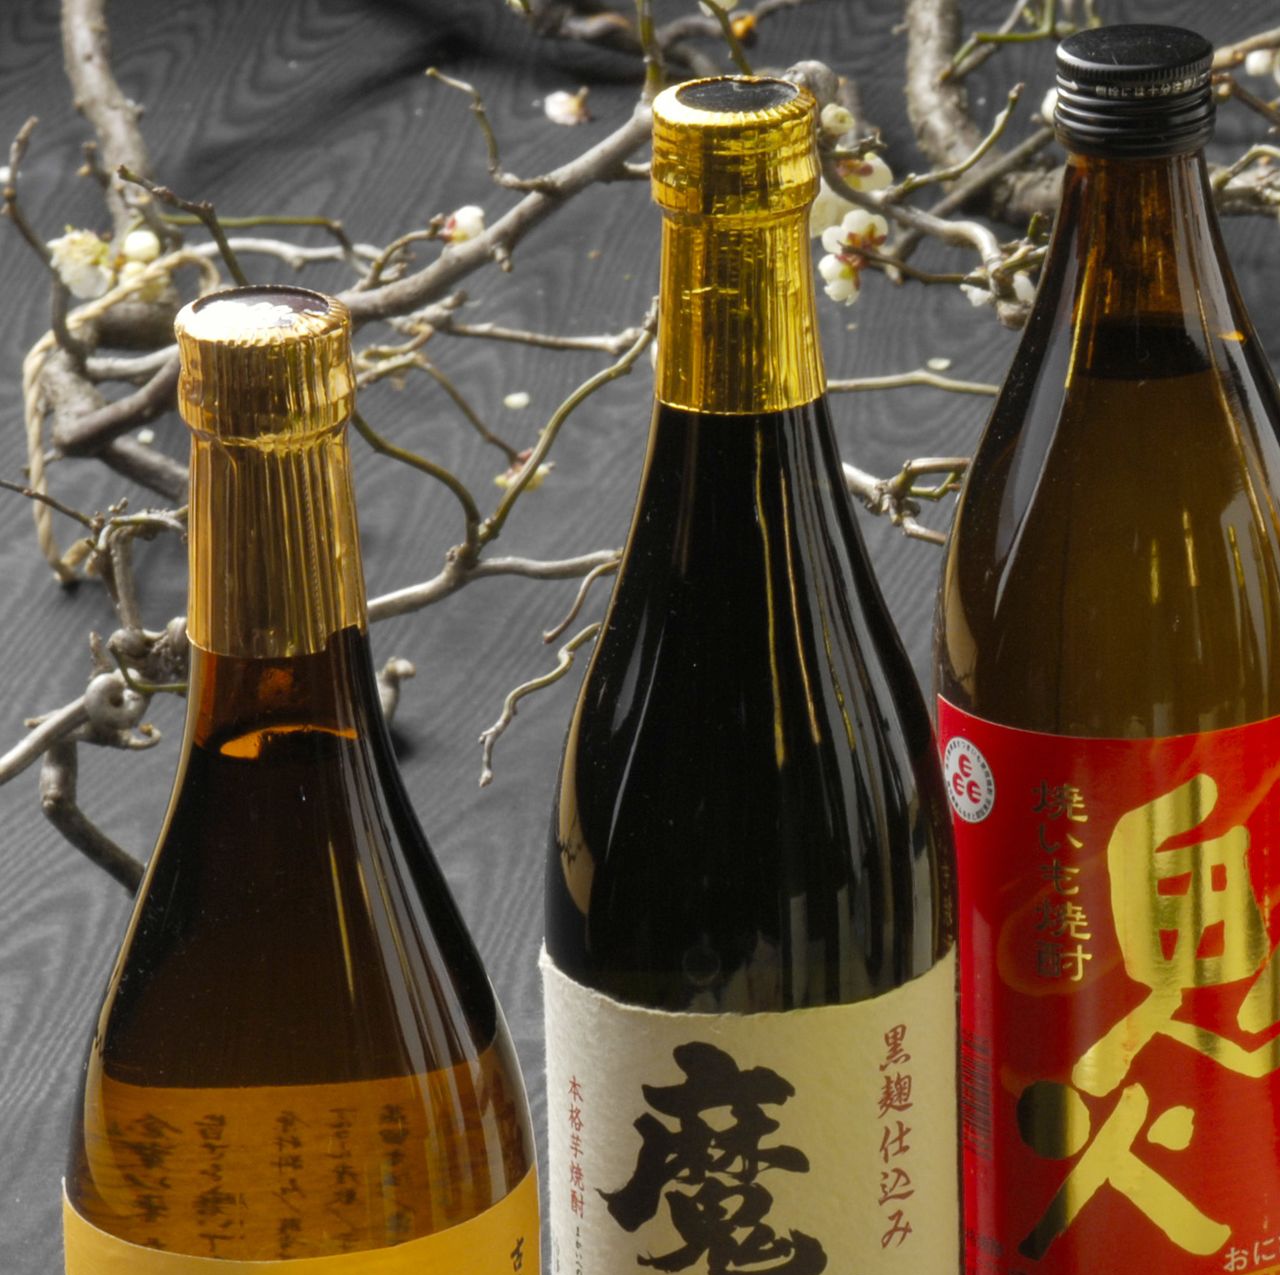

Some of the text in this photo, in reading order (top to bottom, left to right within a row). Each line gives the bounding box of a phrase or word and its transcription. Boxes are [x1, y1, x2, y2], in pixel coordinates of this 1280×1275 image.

[1032, 778, 1094, 984] 焼いも焼酎
[568, 1074, 586, 1220] 本格芋焼酎
[878, 1024, 915, 1250] 黒麹仕込み
